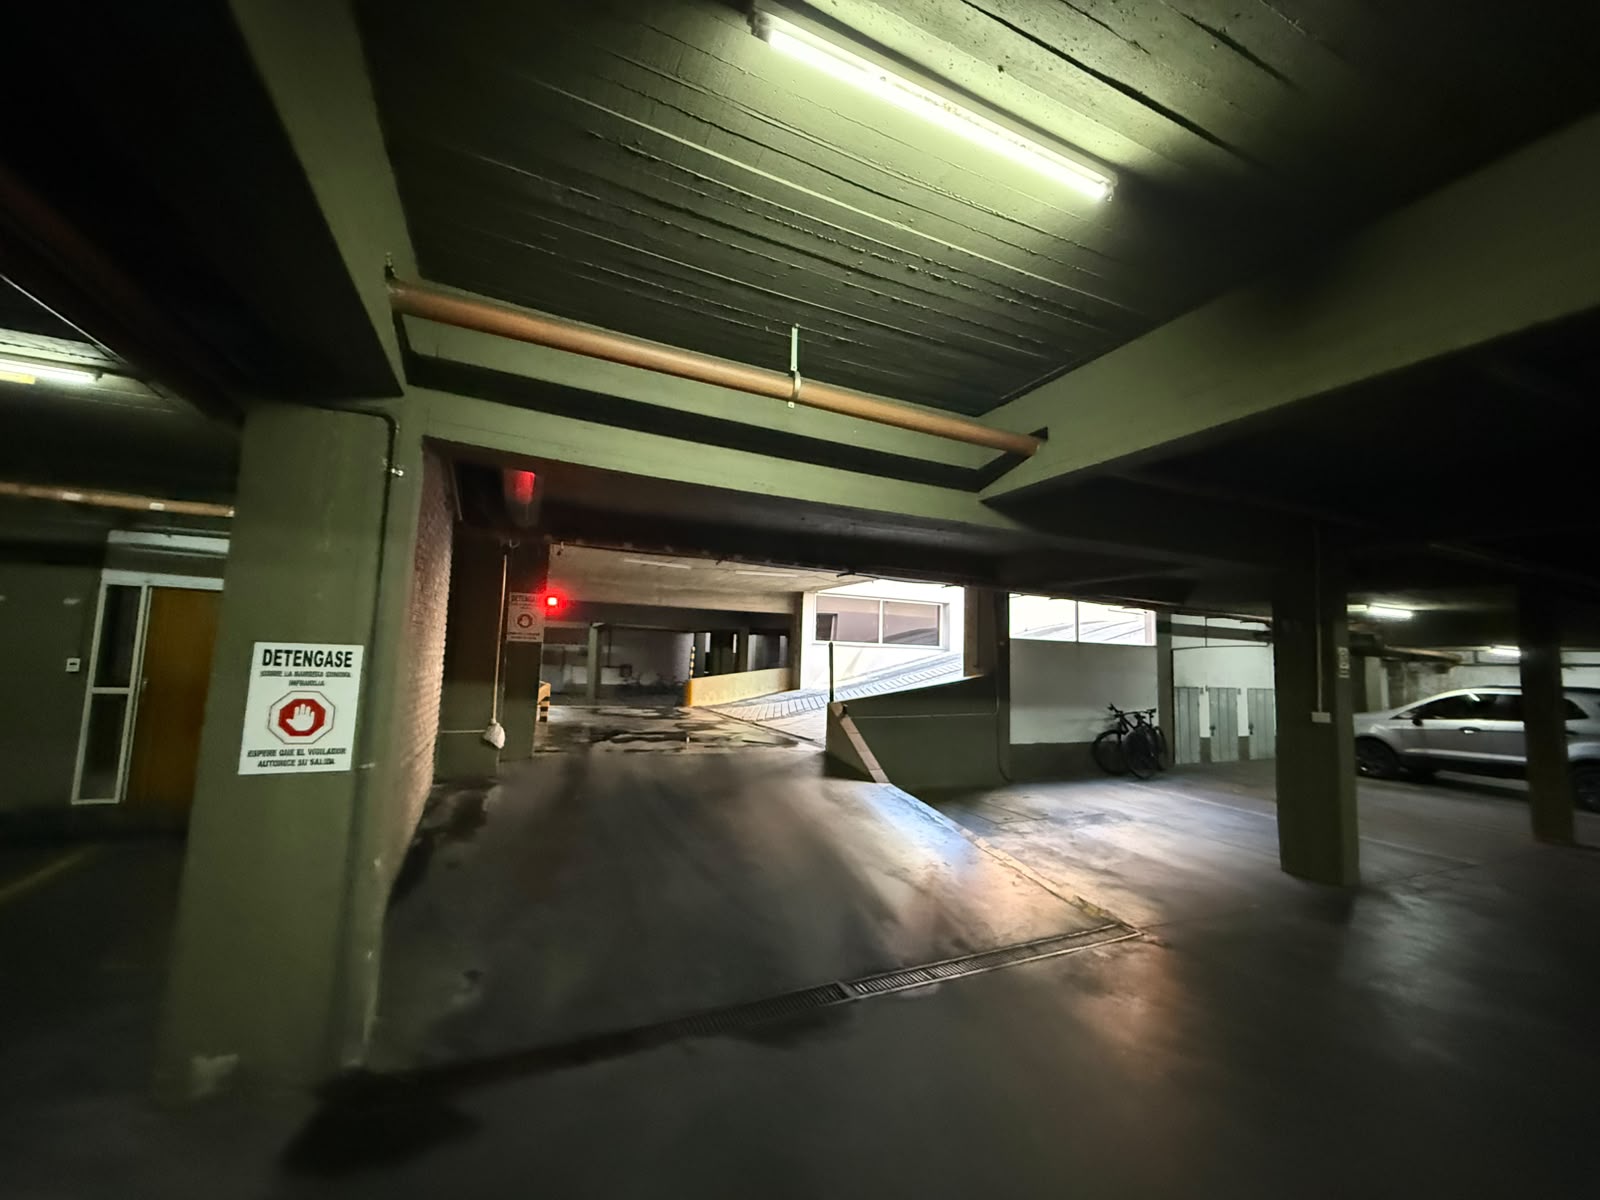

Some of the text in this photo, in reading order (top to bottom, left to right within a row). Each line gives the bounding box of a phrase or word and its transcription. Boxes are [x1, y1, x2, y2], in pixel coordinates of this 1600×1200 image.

[262, 649, 353, 668] DETENGASE
[247, 747, 346, 758] ESPERE QUE EL VIGILADOR
[297, 758, 308, 767] SU
[309, 757, 335, 766] SALIDA
